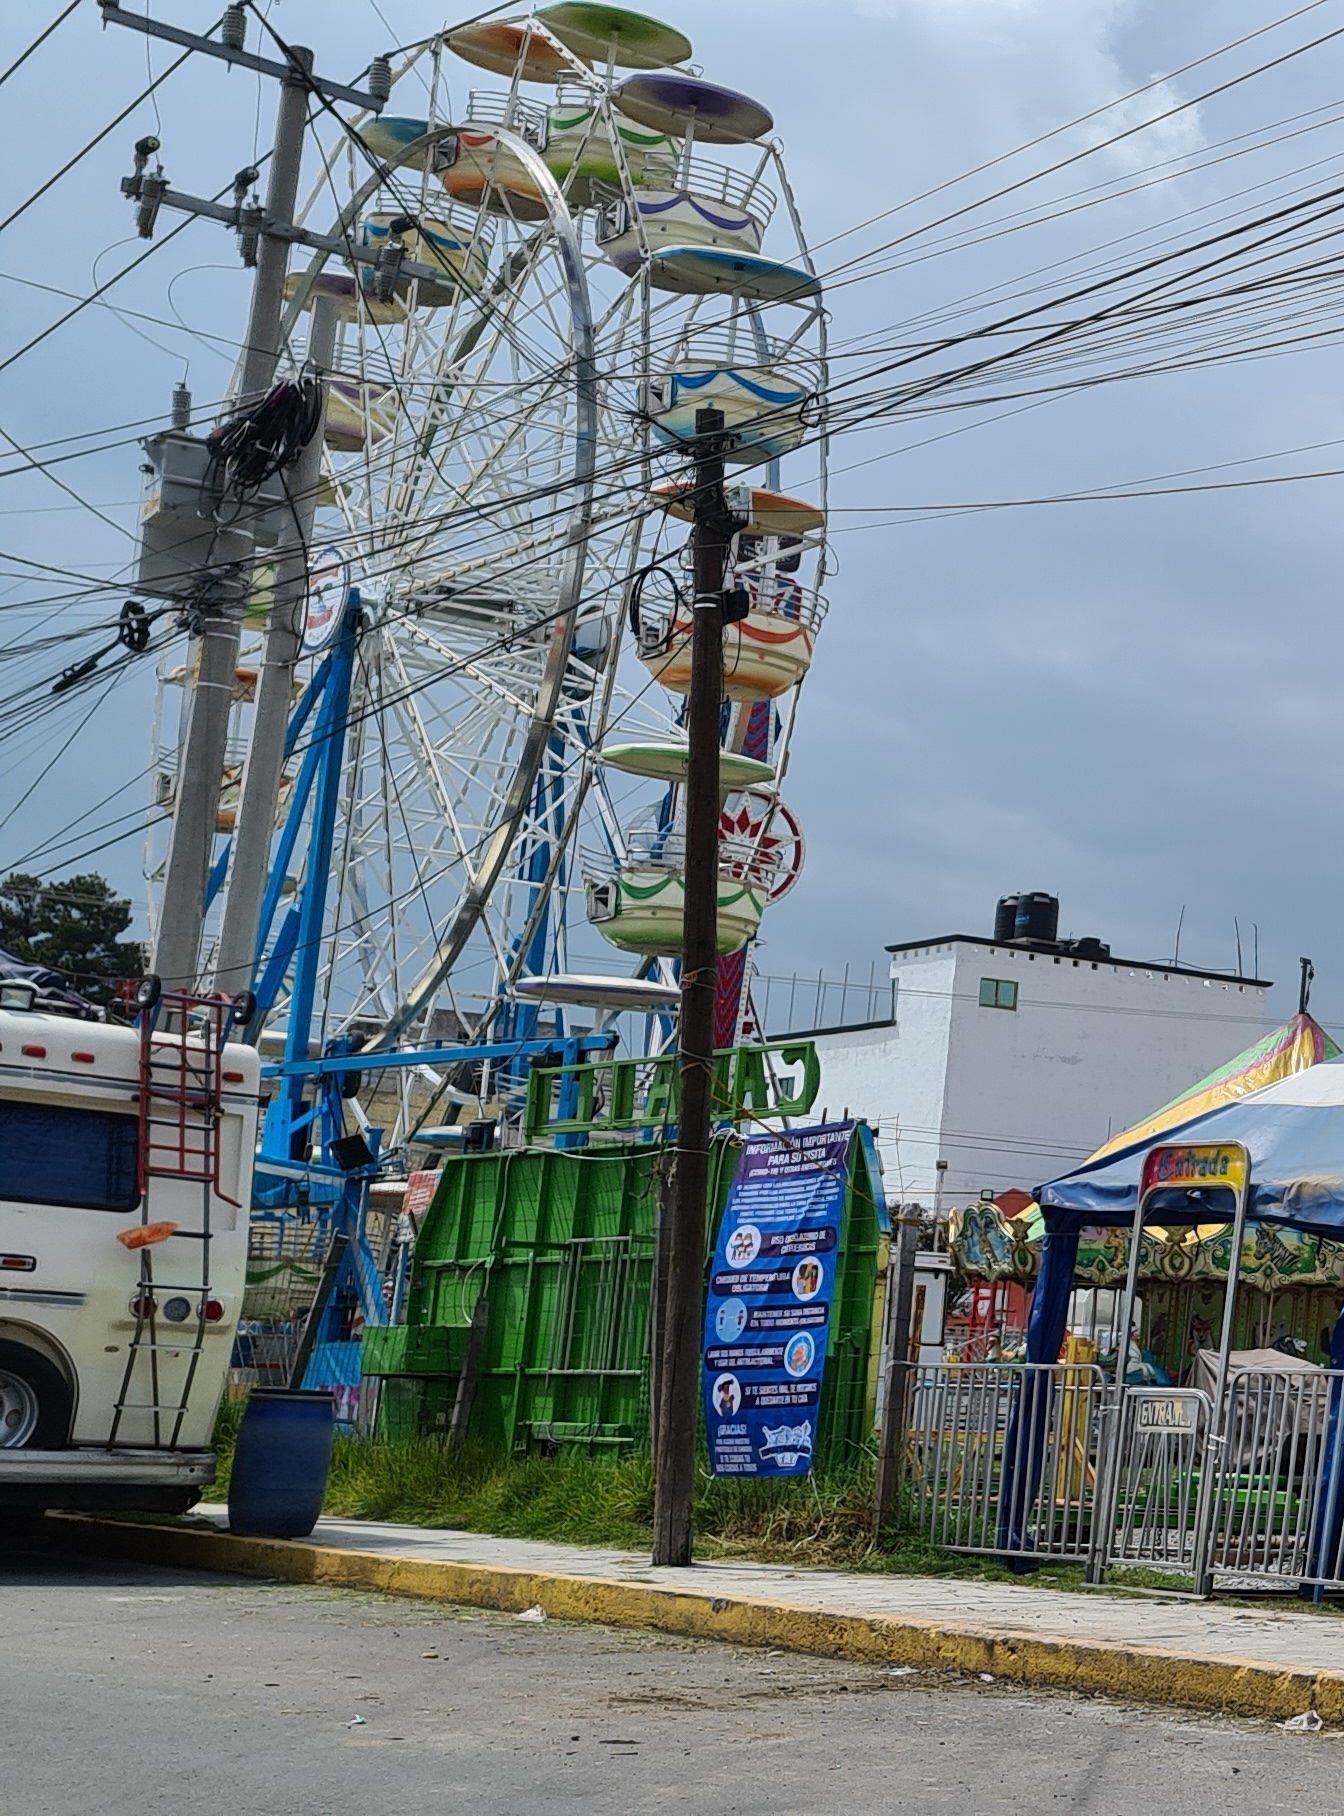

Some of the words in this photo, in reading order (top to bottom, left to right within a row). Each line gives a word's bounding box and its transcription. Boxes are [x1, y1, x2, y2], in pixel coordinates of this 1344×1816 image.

[803, 1130, 851, 1148] IMPORTANTE
[768, 1154, 789, 1166] PARA
[1158, 1147, 1229, 1181] Entrada
